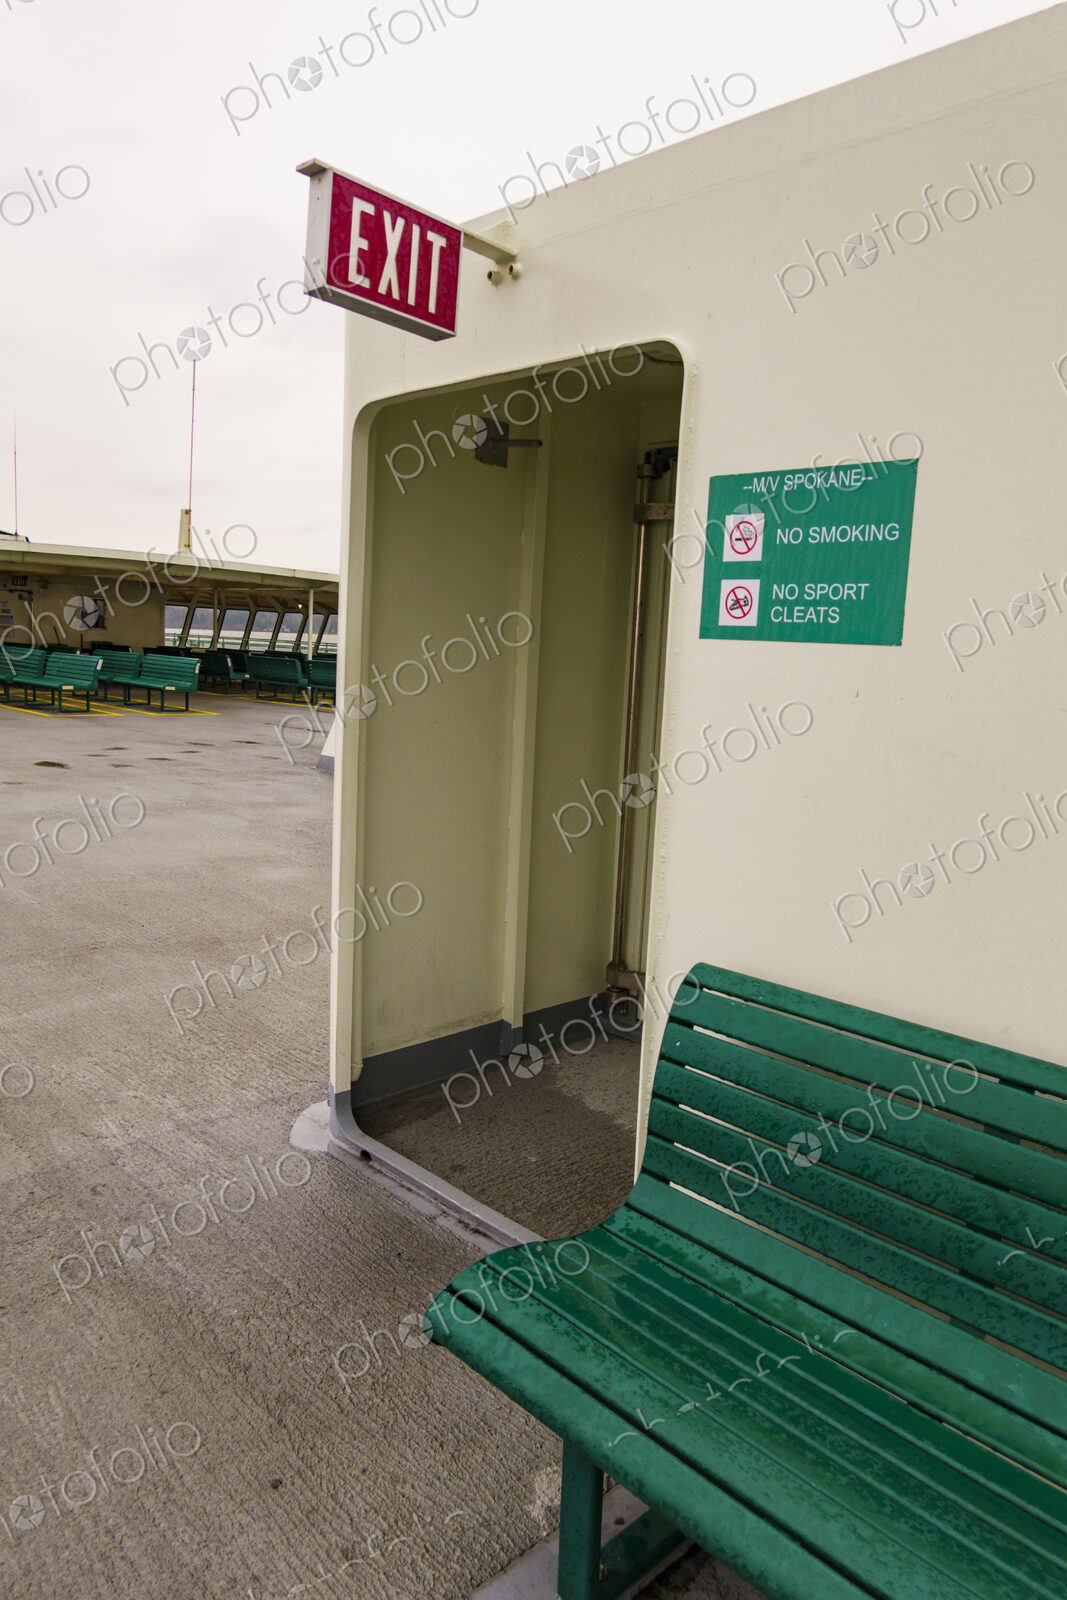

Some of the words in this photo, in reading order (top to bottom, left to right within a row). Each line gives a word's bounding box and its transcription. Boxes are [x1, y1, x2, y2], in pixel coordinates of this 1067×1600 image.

[348, 196, 447, 314] EXIT
[776, 528, 803, 544] NO
[808, 523, 900, 543] SMOKING
[772, 584, 799, 600] NO
[804, 583, 869, 600] SPORT
[770, 606, 840, 623] CLEATS
